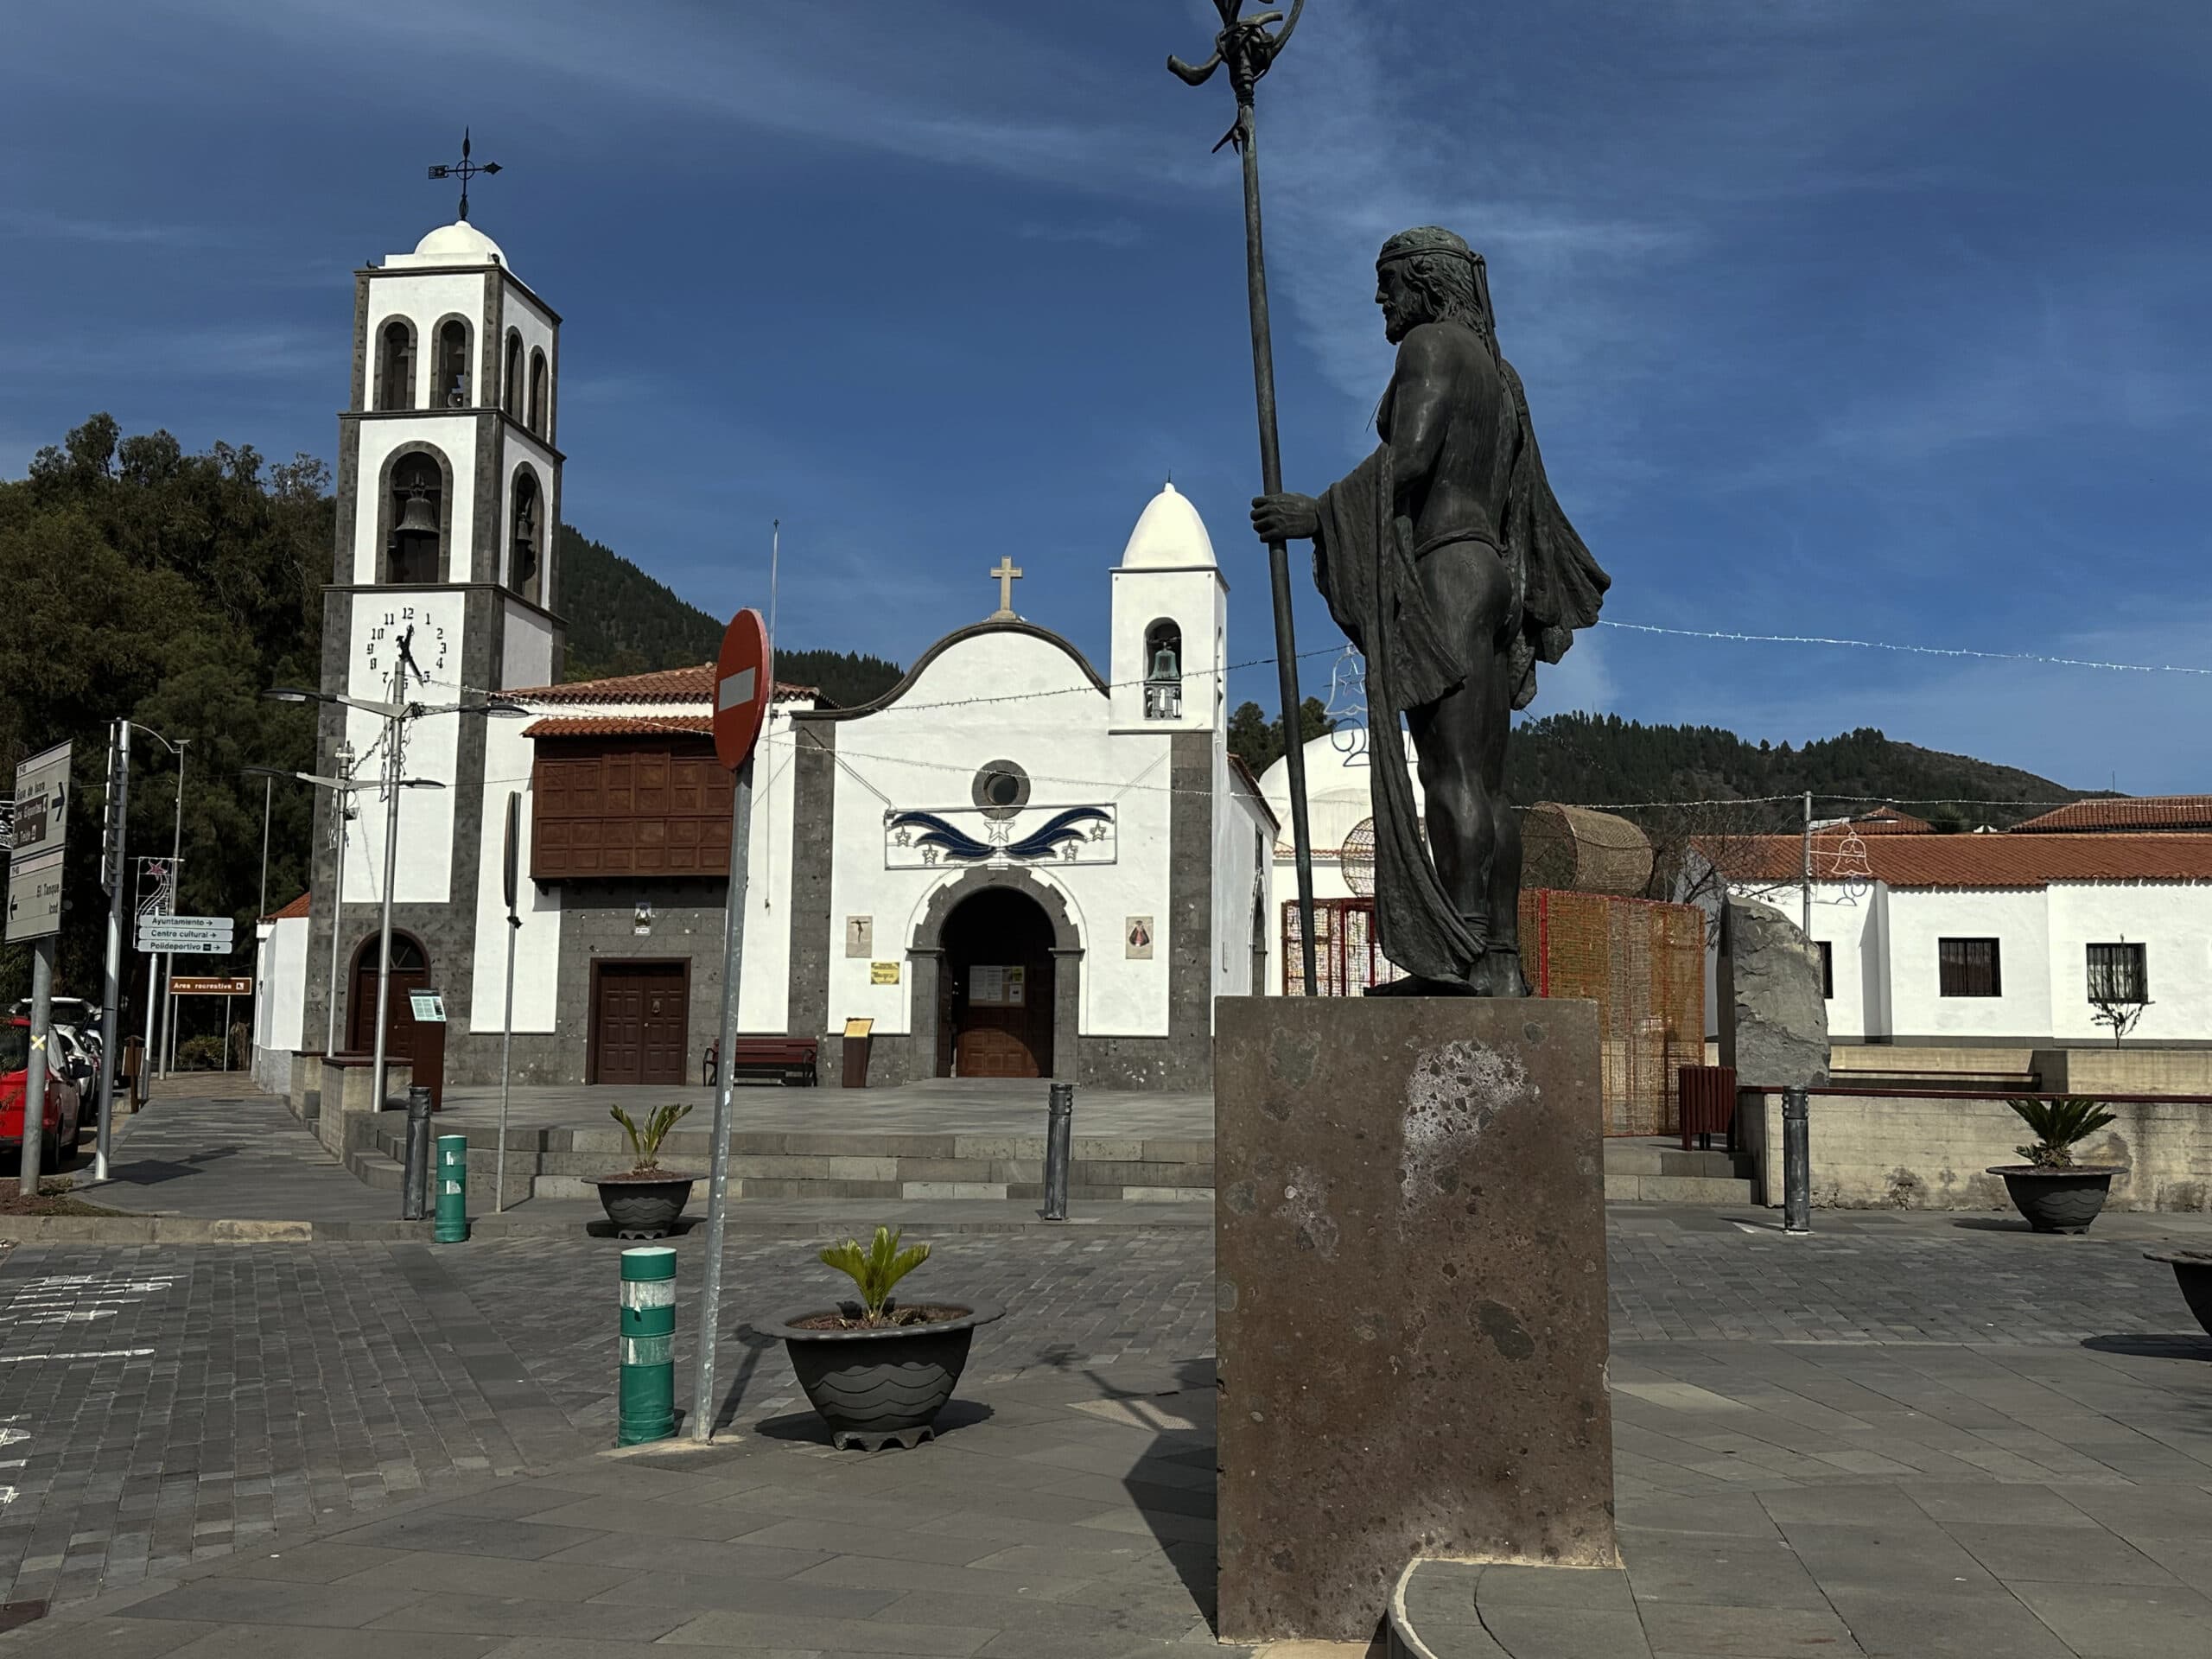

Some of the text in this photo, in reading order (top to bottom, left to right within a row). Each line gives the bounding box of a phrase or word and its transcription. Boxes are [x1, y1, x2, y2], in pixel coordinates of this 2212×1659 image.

[385, 613, 395, 625] 11
[402, 607, 414, 620] 12
[425, 613, 431, 625] 1
[372, 628, 385, 640] 10
[436, 628, 443, 639] 2
[366, 643, 374, 655] 9
[439, 642, 447, 654] 3
[370, 658, 377, 670] 8
[435, 657, 443, 669] 4
[382, 671, 389, 683] 7
[423, 671, 430, 683] 5
[37, 883, 60, 898] El Tanque
[151, 918, 205, 926] Ayuntamiento
[150, 942, 201, 951] Polideportivo
[194, 982, 232, 990] recreativa
